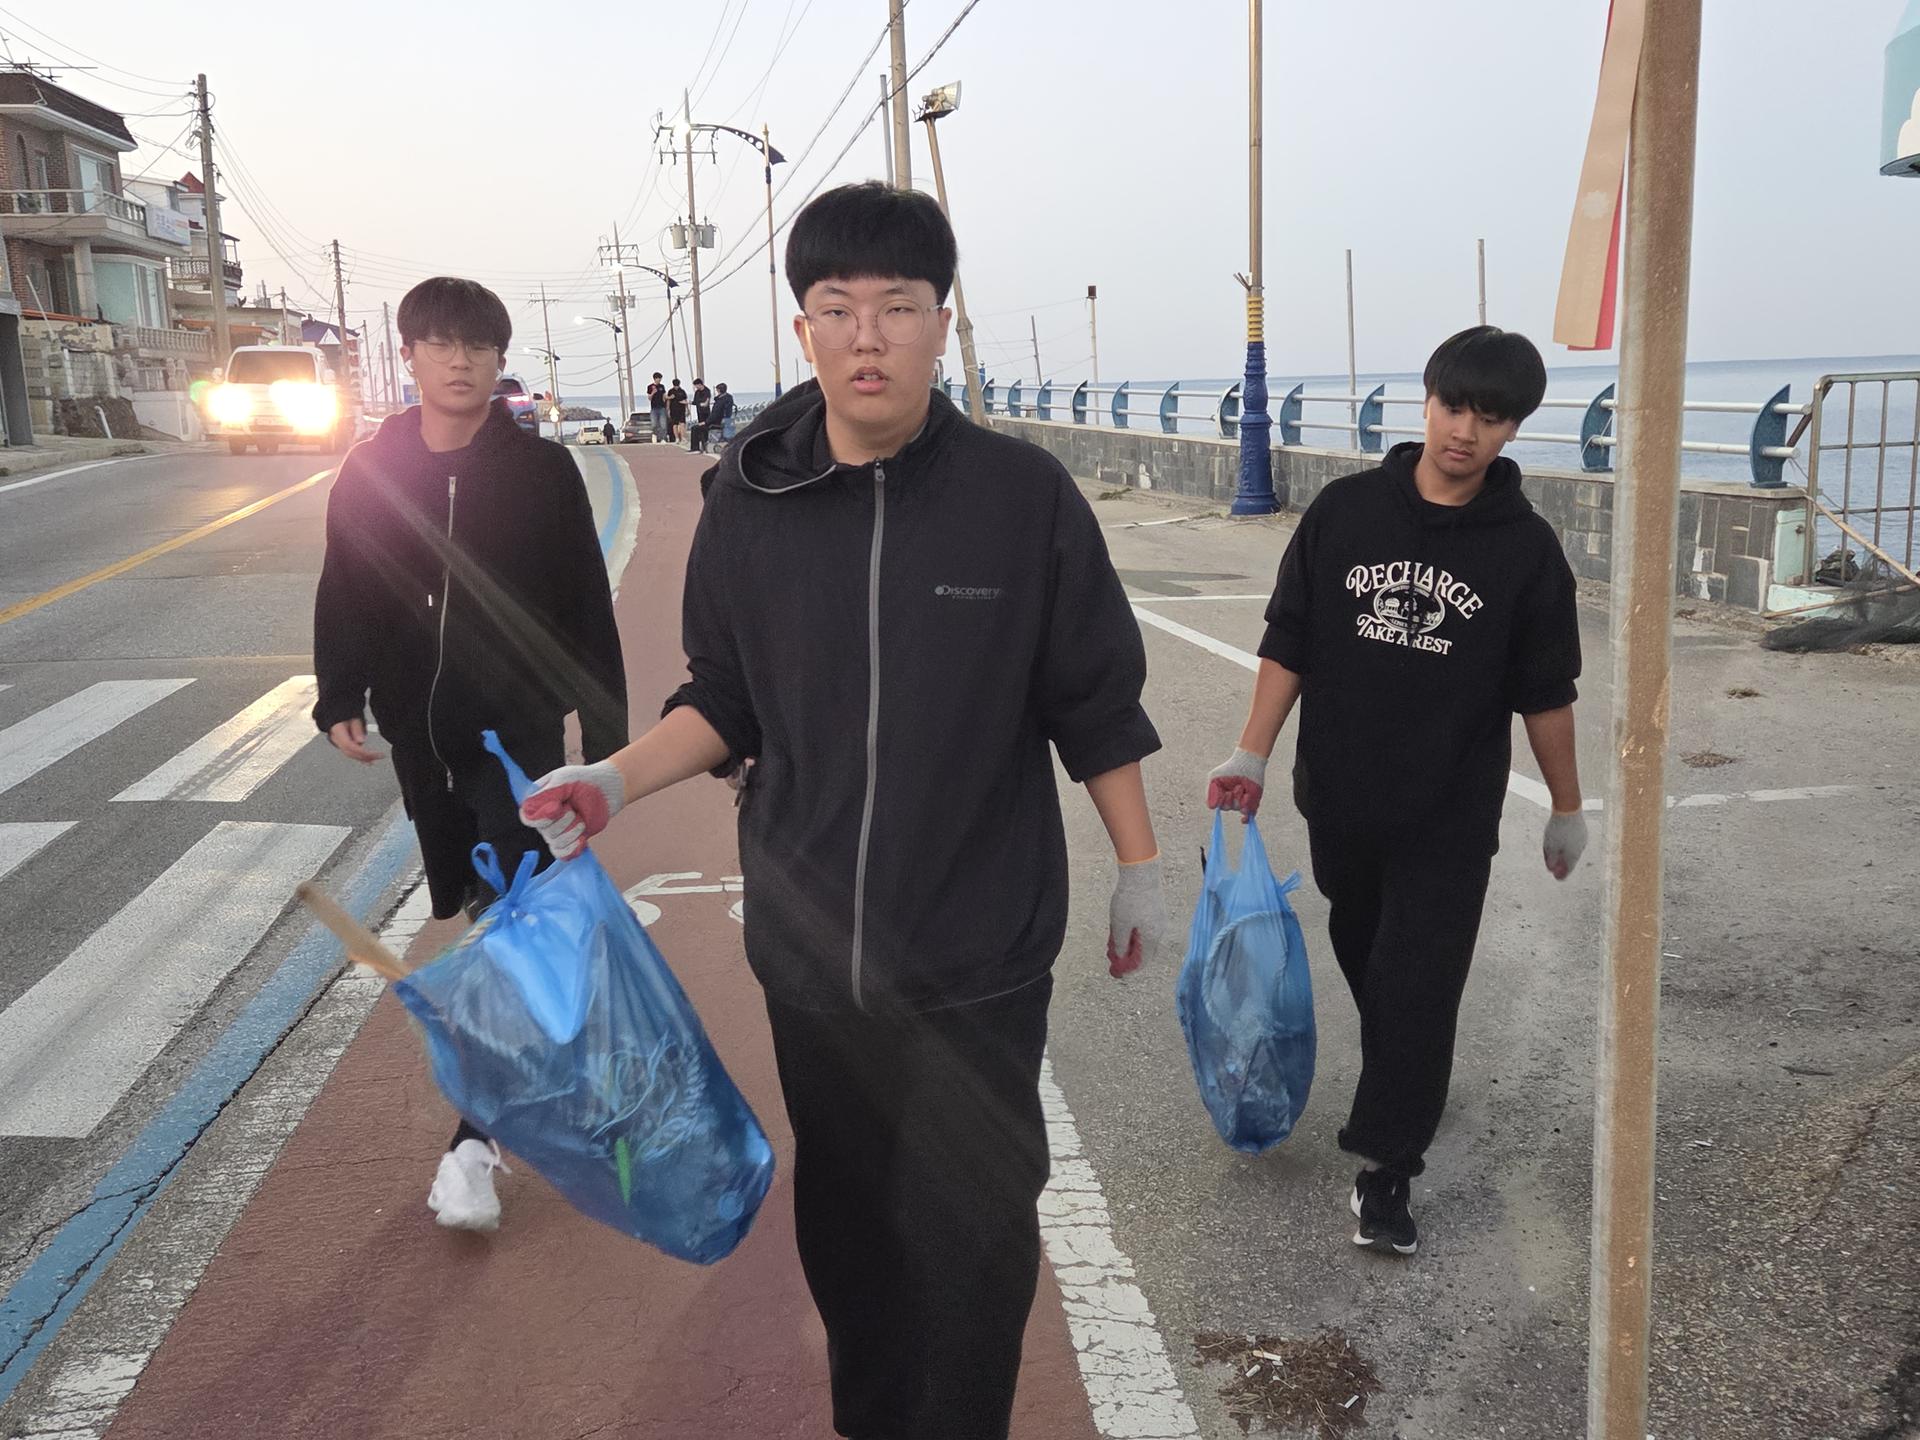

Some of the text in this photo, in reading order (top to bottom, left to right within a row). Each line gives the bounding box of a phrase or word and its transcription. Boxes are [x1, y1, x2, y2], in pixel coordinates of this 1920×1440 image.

[1346, 561, 1484, 620] RECHARGE
[1356, 614, 1396, 643] TAKE
[1396, 631, 1408, 647] A
[1411, 634, 1452, 655] REST
